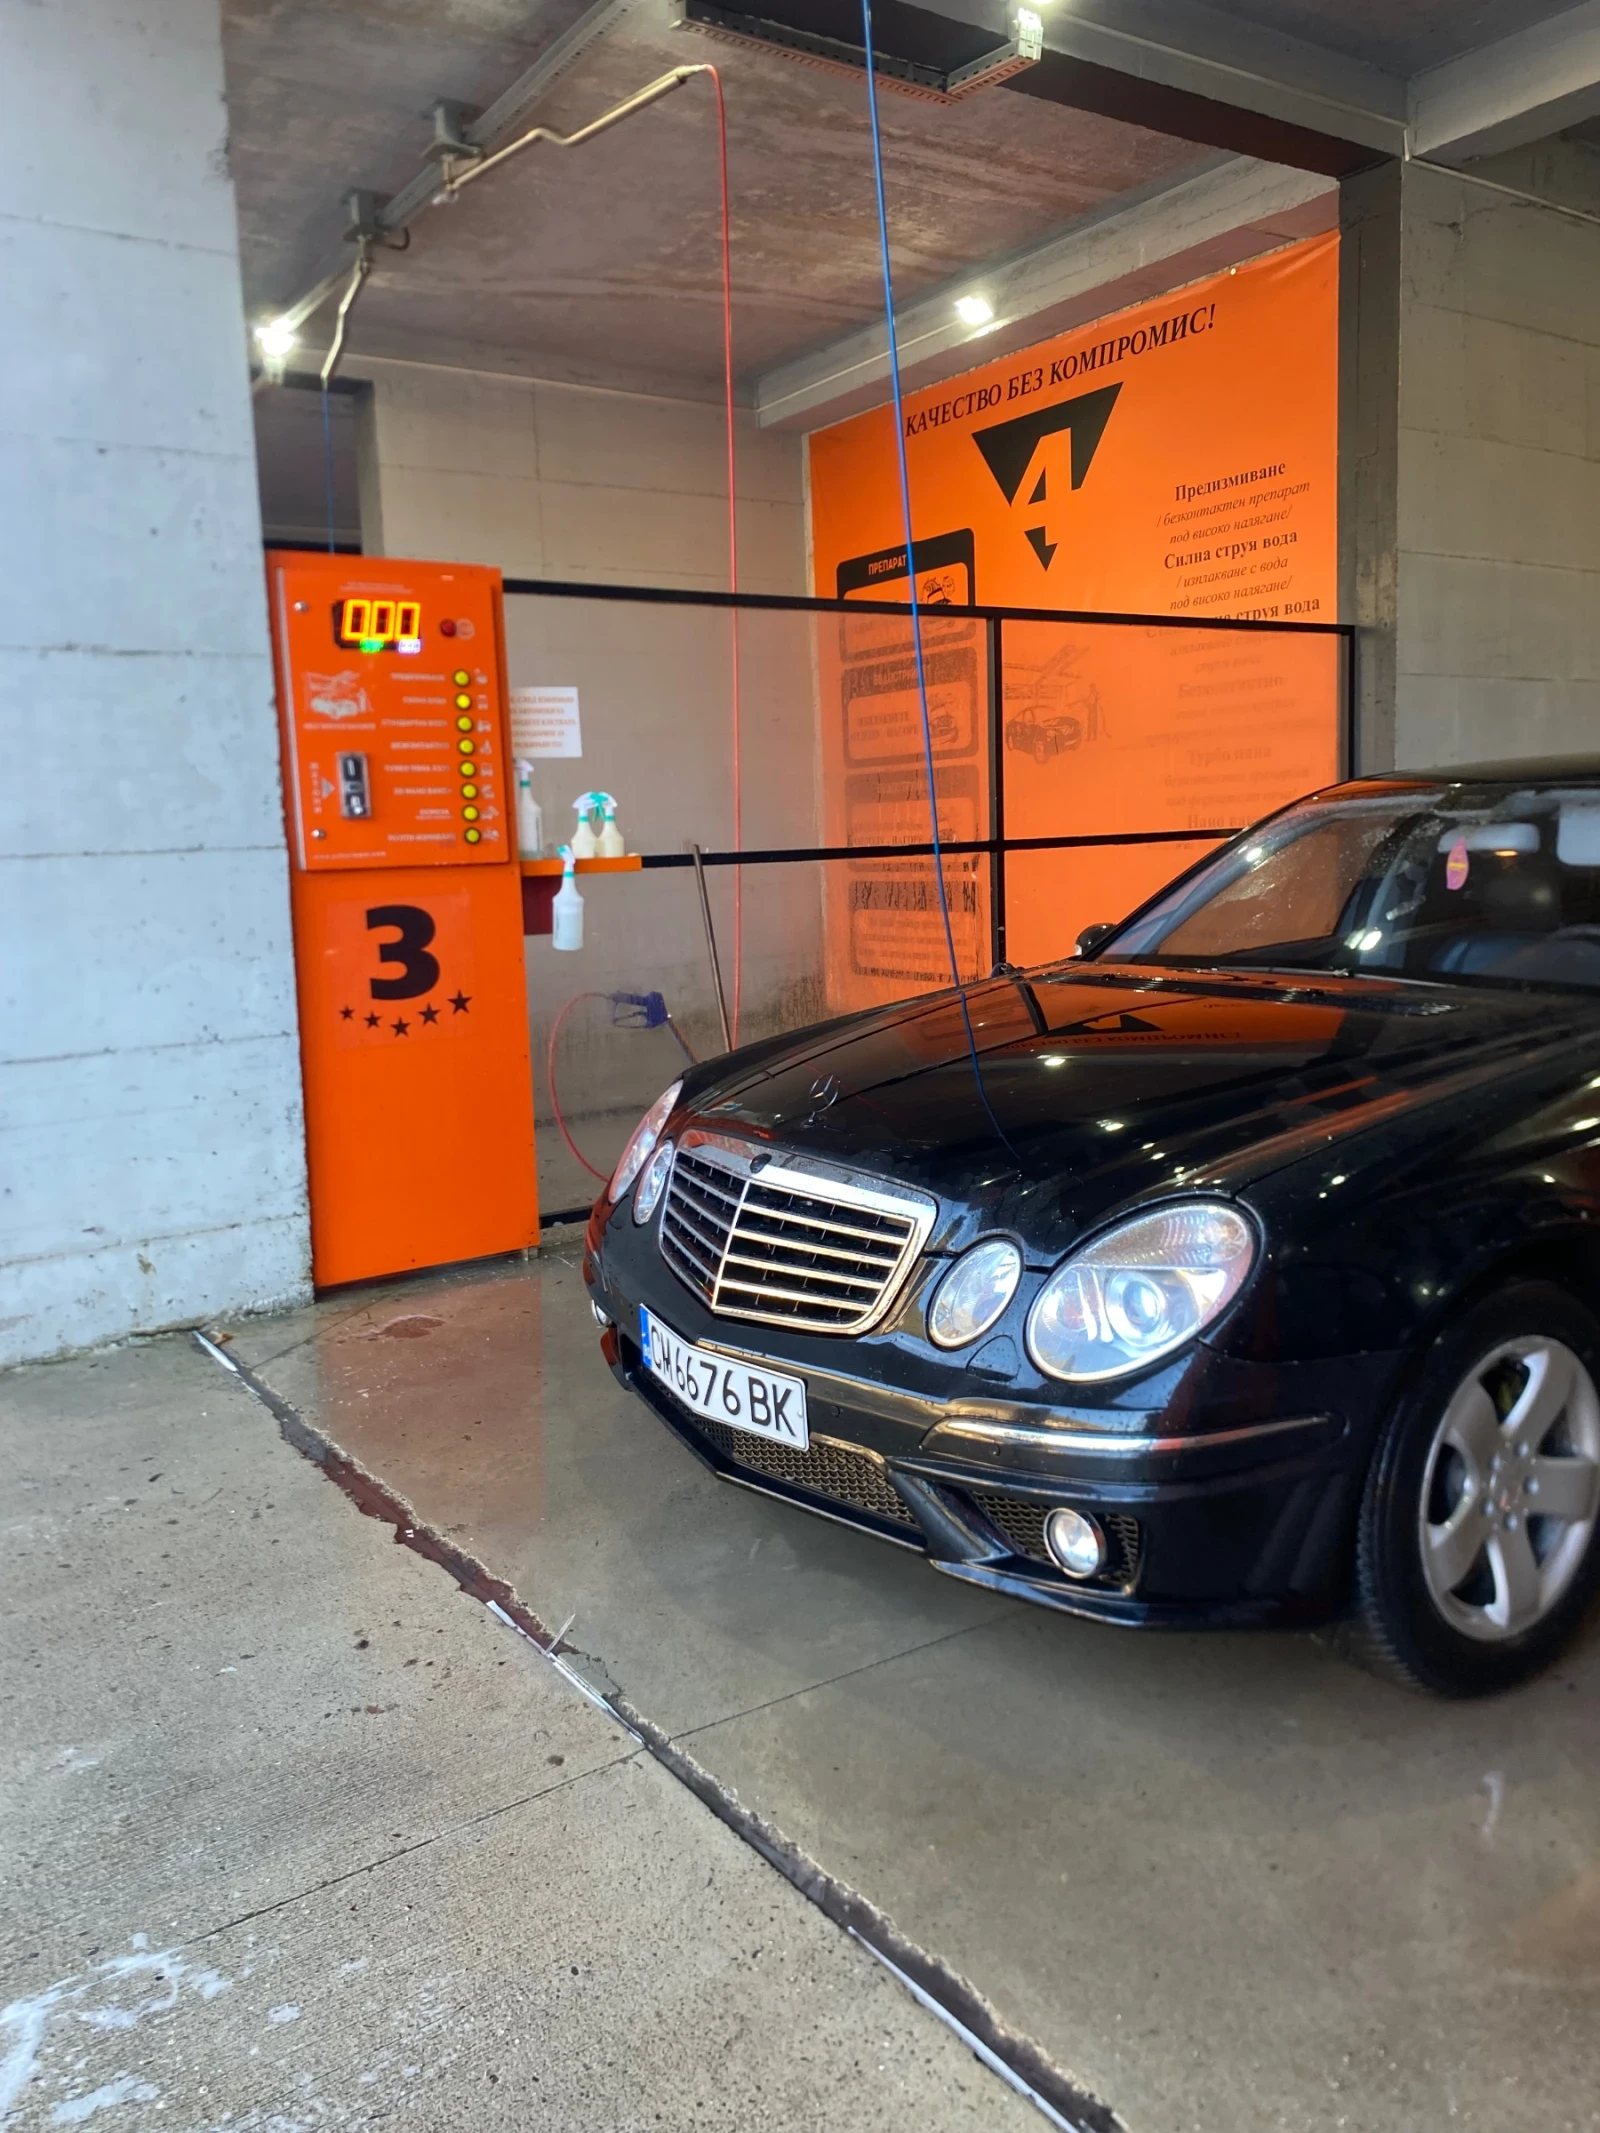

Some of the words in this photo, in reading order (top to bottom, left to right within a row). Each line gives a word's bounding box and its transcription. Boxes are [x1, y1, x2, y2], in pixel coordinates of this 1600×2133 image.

[905, 384, 1002, 437] КАЧЕСТВО
[1007, 367, 1043, 401] БЕЗ
[1049, 303, 1215, 386] КОМПРОМИС!
[1174, 462, 1286, 502] Предизмиване
[1249, 482, 1310, 506] препарат
[1170, 530, 1190, 545] под
[1193, 523, 1231, 541] високо
[1164, 549, 1212, 570] Силна
[1216, 540, 1258, 561] струя
[1262, 531, 1298, 550] вода
[1260, 556, 1288, 573] вода
[1170, 597, 1190, 611] под
[1193, 589, 1231, 607] високо
[1284, 597, 1320, 615] вода
[366, 904, 440, 1000] 3
